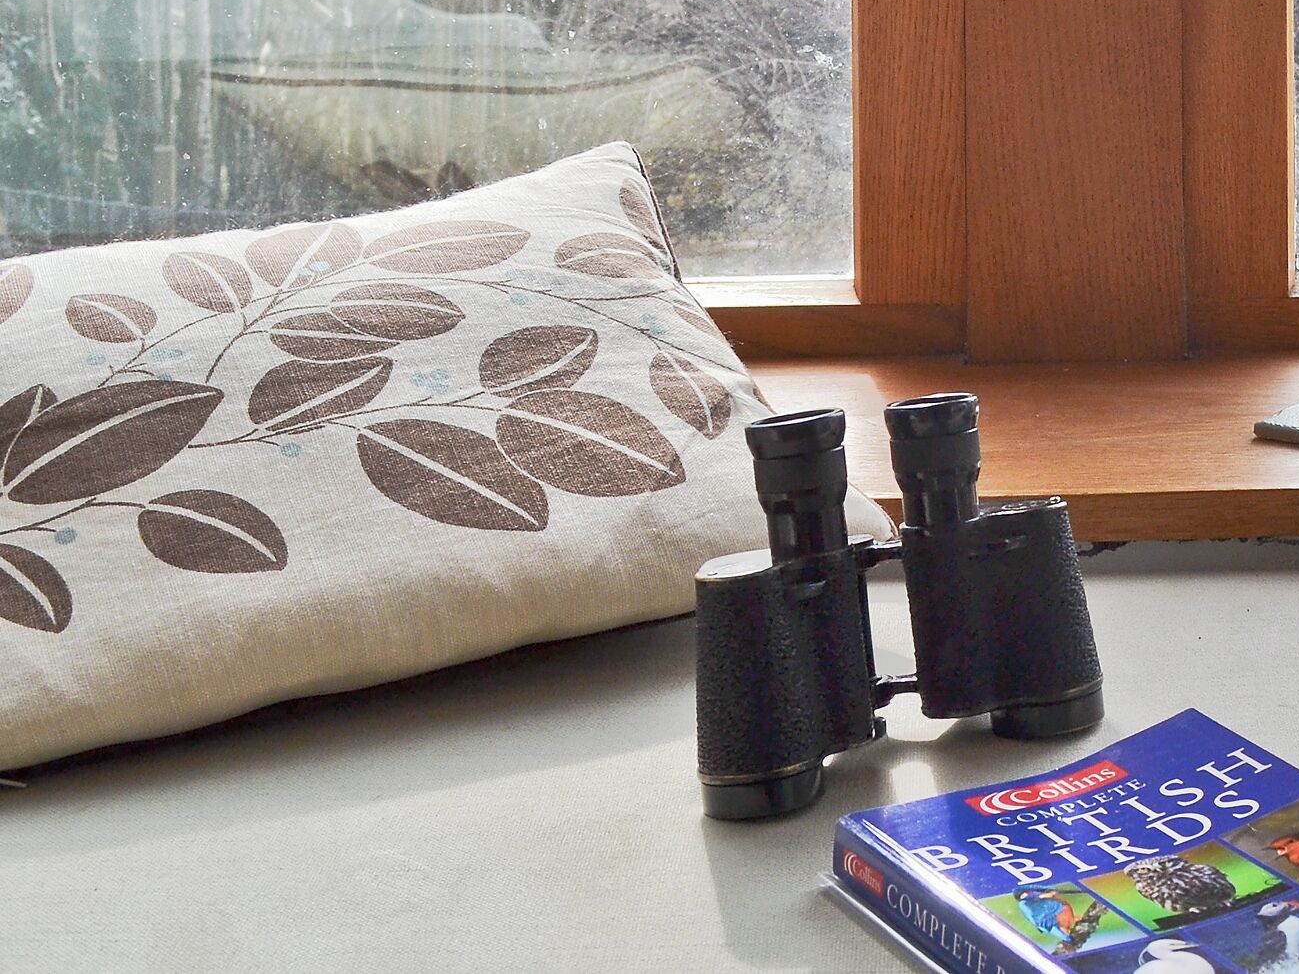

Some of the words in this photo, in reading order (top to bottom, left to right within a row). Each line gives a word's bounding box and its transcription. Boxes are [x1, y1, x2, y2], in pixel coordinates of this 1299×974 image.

[908, 747, 1273, 872] BRITISH
[996, 778, 1147, 827] COMPLETE
[1009, 767, 1117, 804] Collins
[990, 789, 1261, 886] BIRDS
[851, 852, 882, 894] Collins
[886, 883, 988, 974] COMPLETE
